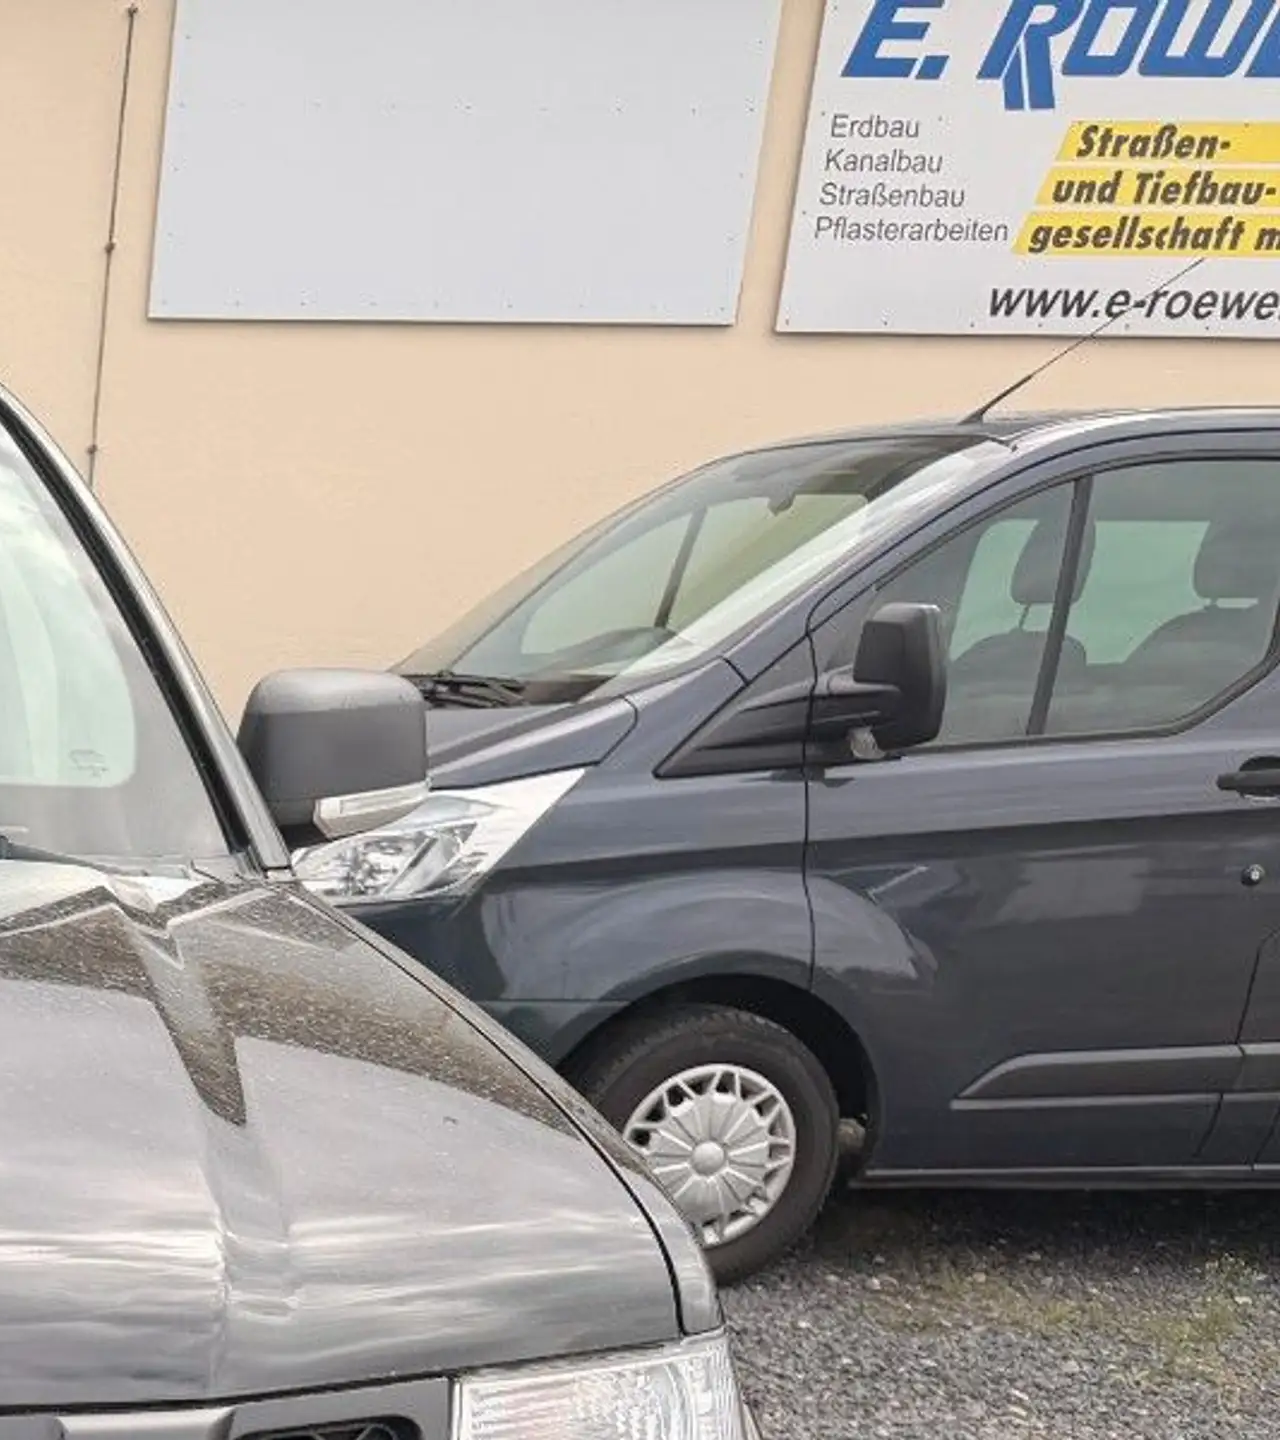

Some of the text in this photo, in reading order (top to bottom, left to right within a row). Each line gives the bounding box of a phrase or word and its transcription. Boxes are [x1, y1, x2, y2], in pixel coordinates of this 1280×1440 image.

[830, 114, 920, 138] Erdbau
[1076, 124, 1232, 159] Straßen-
[824, 149, 942, 173] Kanalbau
[819, 183, 965, 208] Straßenbau
[1052, 171, 1277, 205] und Tiefbau-
[814, 217, 1009, 243] Pflasterarbeiten
[1029, 215, 1245, 254] gesellschaft
[989, 287, 1280, 320] www.e-roewe
